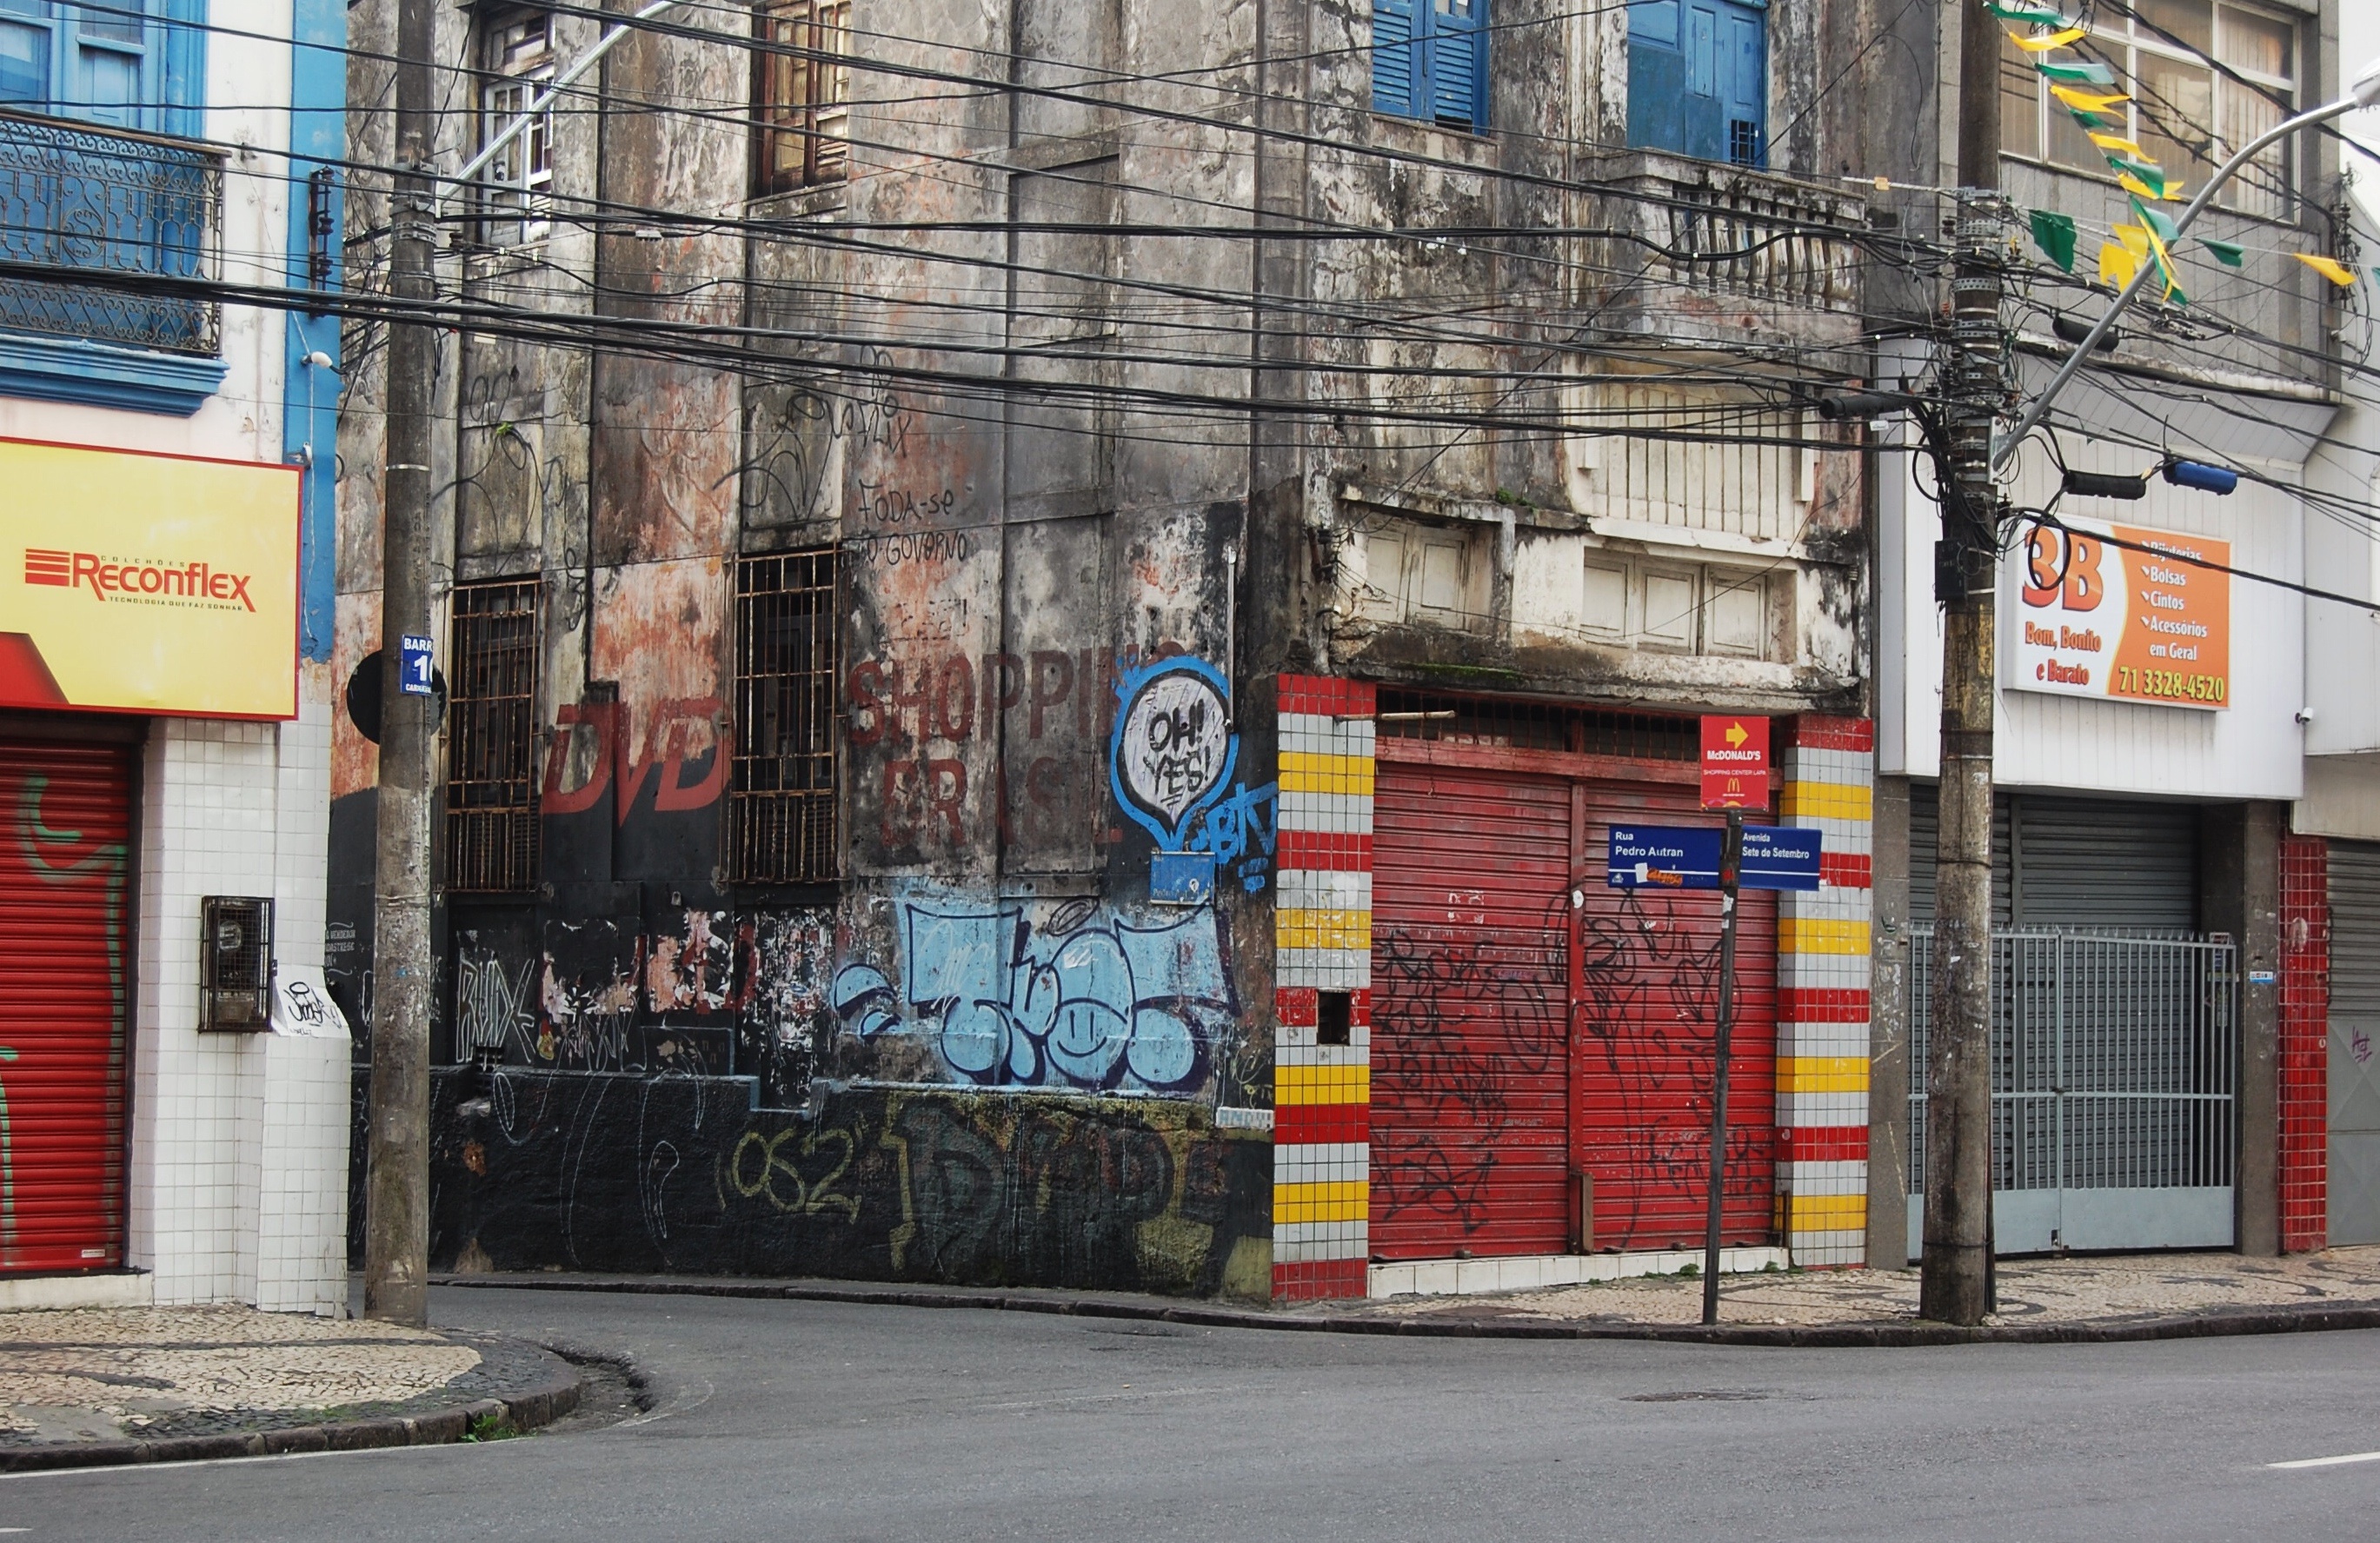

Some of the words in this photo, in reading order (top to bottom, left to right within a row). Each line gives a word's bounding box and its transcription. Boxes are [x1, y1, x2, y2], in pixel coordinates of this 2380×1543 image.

[2022, 527, 2104, 612] 3B
[2150, 566, 2186, 586] Bolsas
[109, 595, 165, 606] TECNOLOGIA
[2150, 590, 2184, 610] Cintos
[2024, 621, 2058, 651] Bom,
[2061, 625, 2102, 653] Bonito
[2150, 615, 2208, 638] Acessórios
[2150, 643, 2166, 657] em
[2169, 642, 2197, 662] Geral
[2036, 662, 2045, 681] e
[2048, 658, 2091, 686] Barato
[2119, 665, 2138, 693] 71
[2143, 668, 2225, 702] 3328-4520
[1149, 698, 1206, 754] OH!
[541, 697, 738, 828] DVD
[1143, 746, 1212, 795] YES!
[1615, 831, 1634, 841] Rua
[1742, 832, 1771, 842] Avenida
[1615, 845, 1646, 856] Pedro
[1648, 846, 1684, 857] Autran
[1742, 846, 1759, 857] Sete
[1761, 848, 1772, 857] de
[1772, 847, 1810, 859] Setembro
